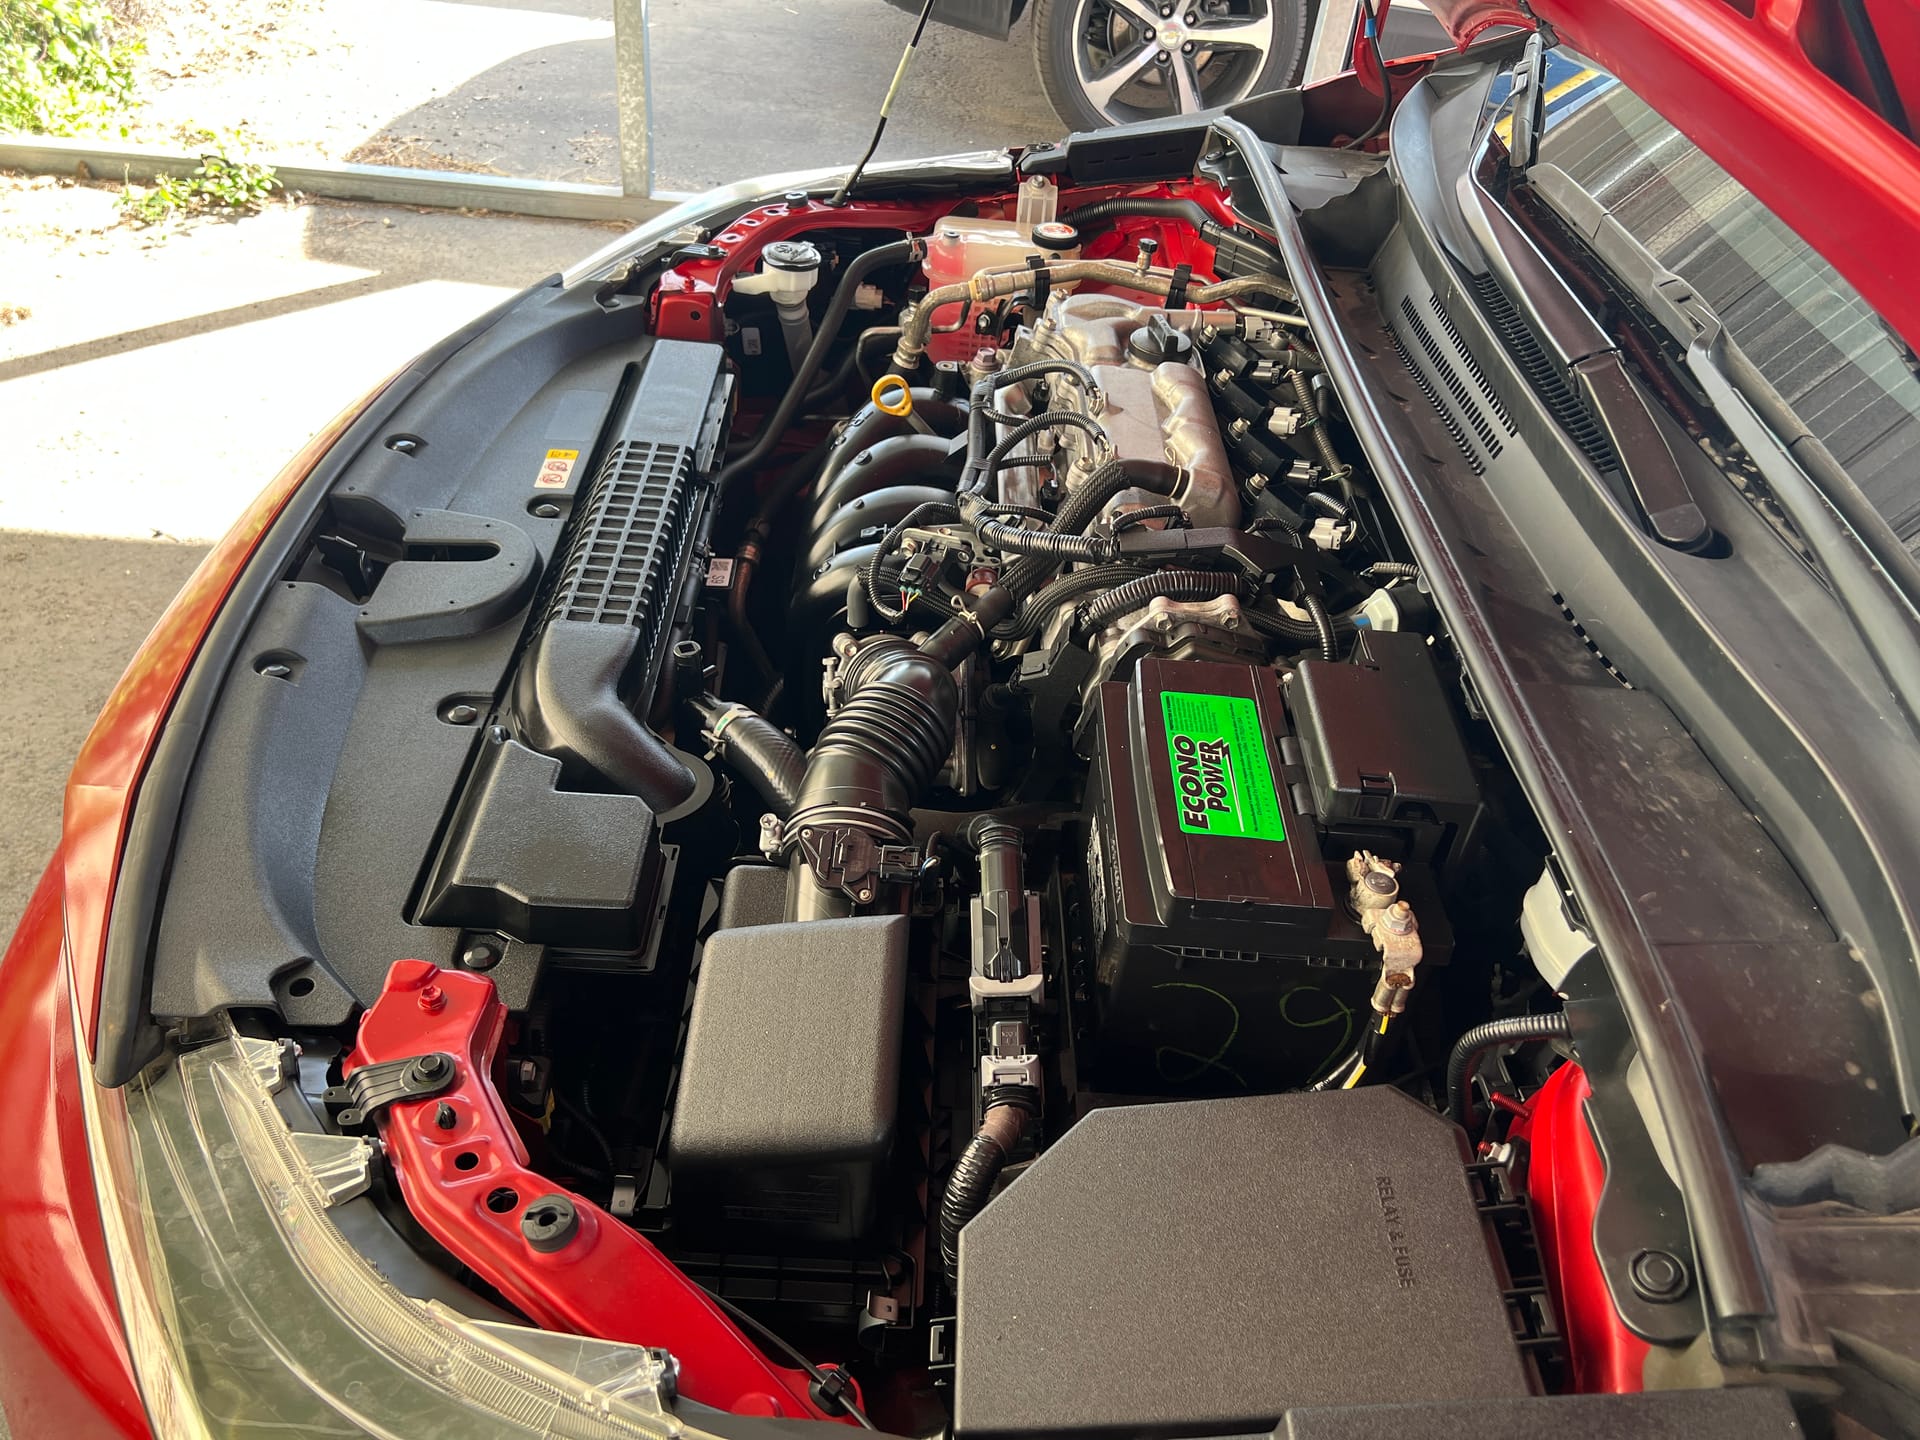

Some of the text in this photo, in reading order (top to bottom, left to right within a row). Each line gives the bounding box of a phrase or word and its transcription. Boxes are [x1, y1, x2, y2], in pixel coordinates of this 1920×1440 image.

[1173, 734, 1210, 830] ECONO
[1198, 737, 1231, 813] POWER
[1375, 1176, 1416, 1288] RELAY & FUSE
